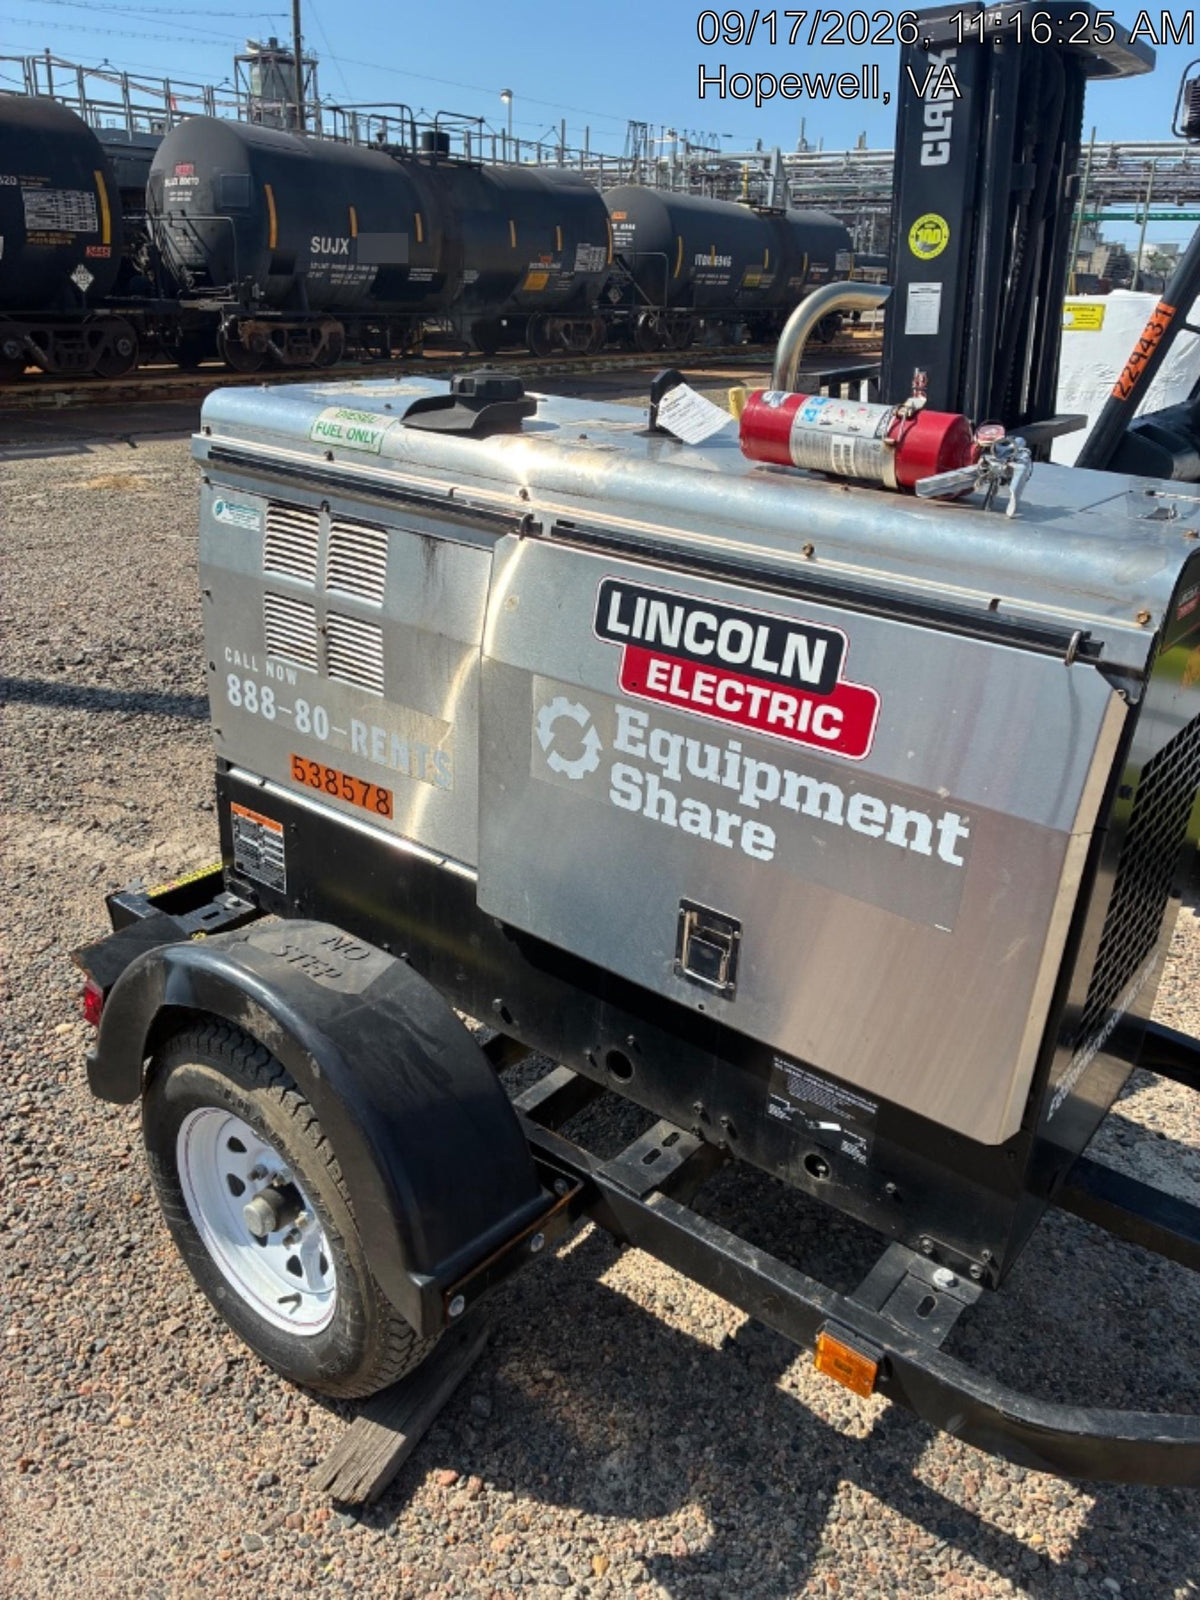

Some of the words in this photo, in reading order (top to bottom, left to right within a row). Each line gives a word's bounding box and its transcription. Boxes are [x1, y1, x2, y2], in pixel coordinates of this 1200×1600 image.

[310, 235, 350, 255] SUJX
[1114, 307, 1174, 399] 229431
[315, 420, 343, 439] FUEL
[346, 427, 379, 445] ONLY
[224, 646, 259, 673] CALL
[265, 660, 298, 686] NOW
[605, 590, 828, 685] LINCOLN
[226, 672, 452, 790] 888-80-RENTS
[645, 657, 845, 741] ELECTRIC
[292, 755, 391, 816] 538578
[608, 760, 777, 862] Share
[612, 703, 971, 867] Equipment
[271, 944, 344, 979] STEP
[319, 935, 371, 961] NO
